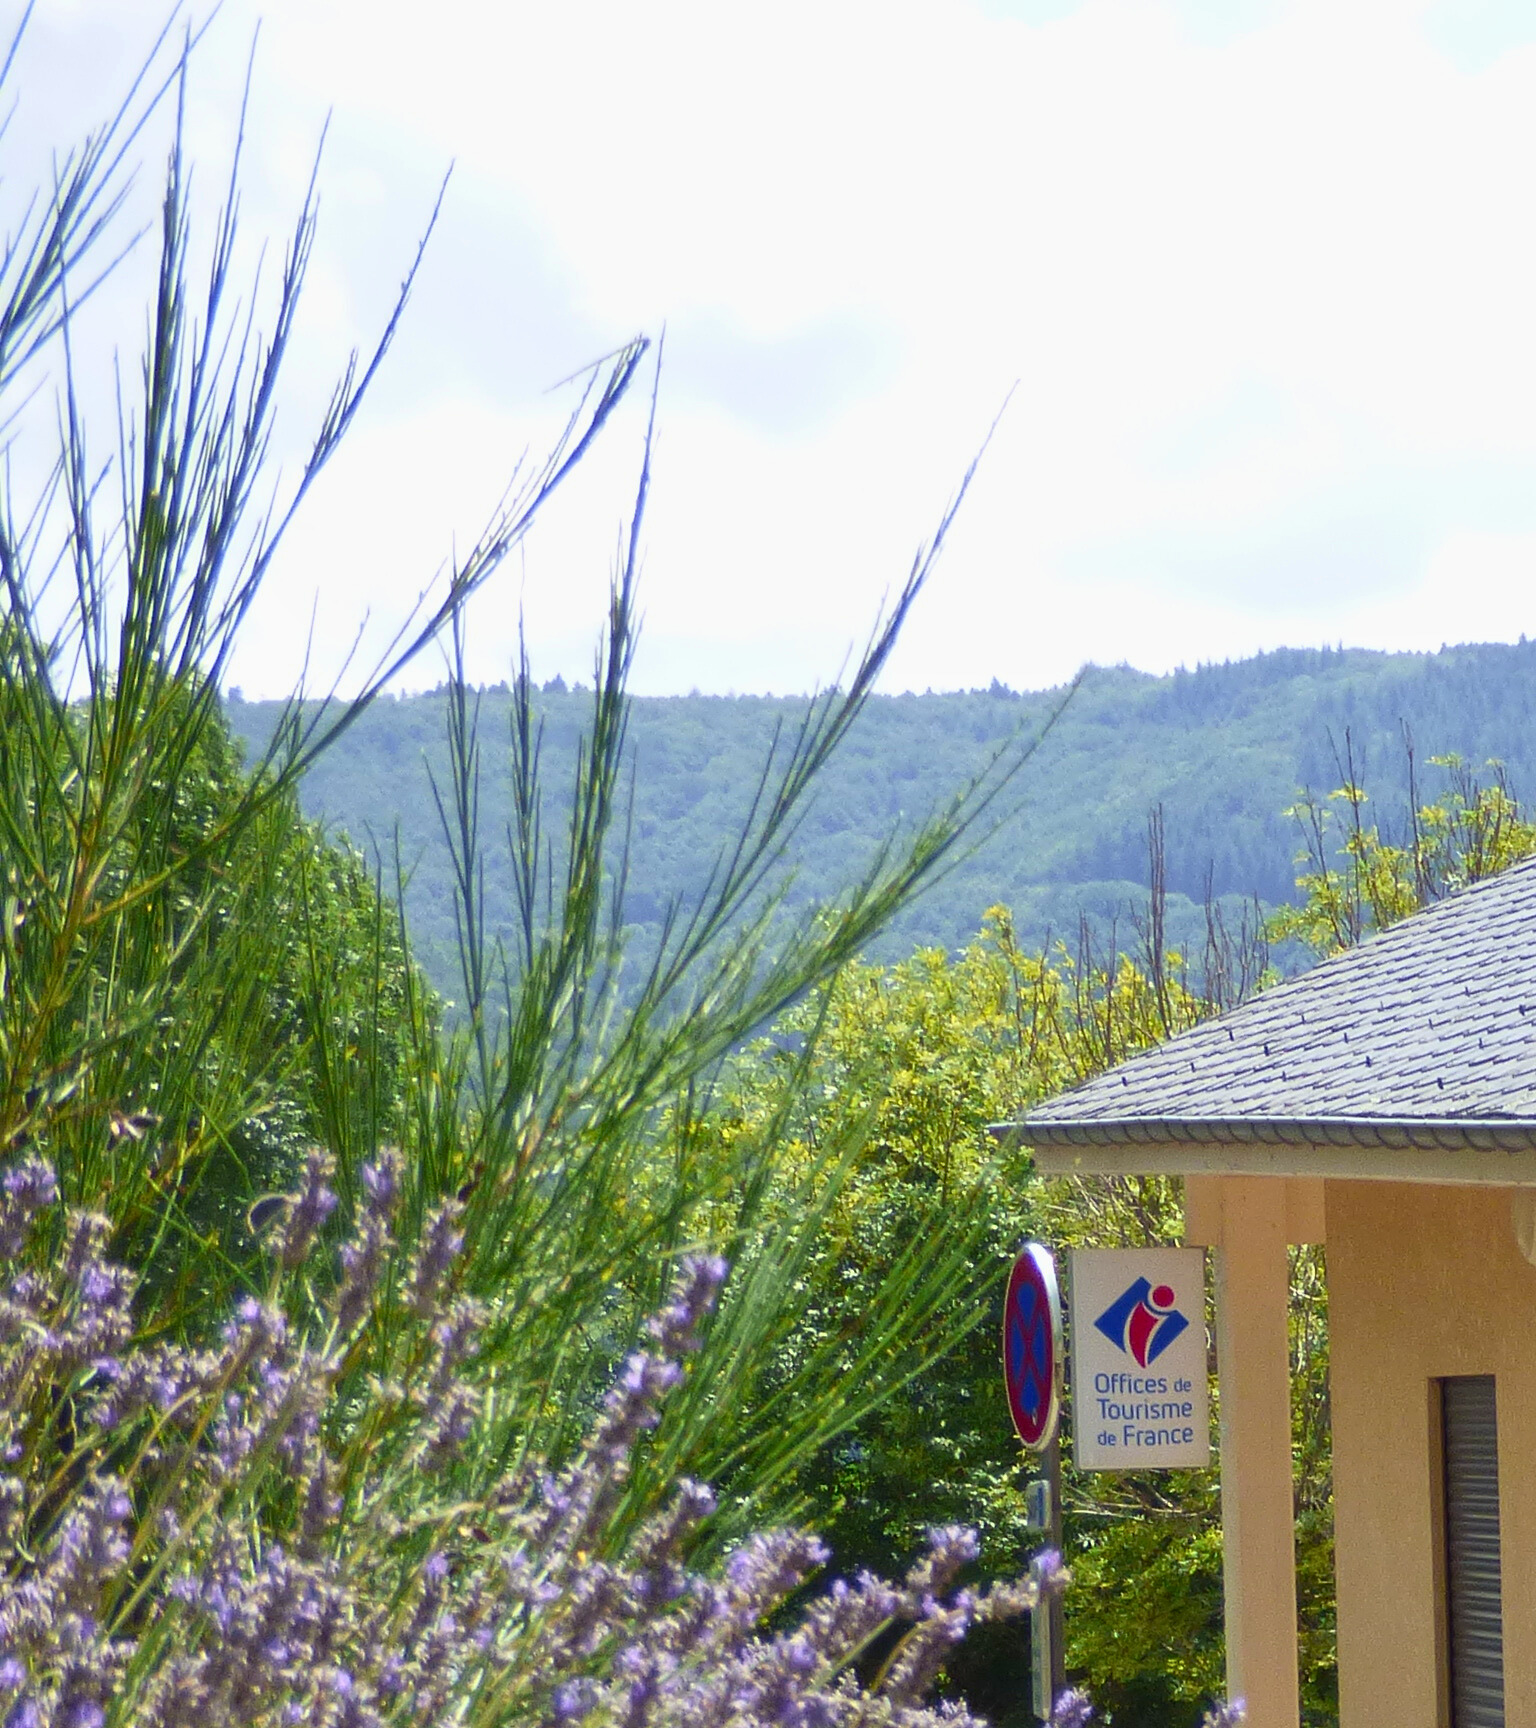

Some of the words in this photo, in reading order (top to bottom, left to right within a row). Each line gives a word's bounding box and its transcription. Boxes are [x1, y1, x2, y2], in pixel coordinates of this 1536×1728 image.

[1094, 1373, 1168, 1394] Offices
[1174, 1377, 1192, 1393] de
[1096, 1398, 1193, 1420] Tourisme
[1097, 1430, 1117, 1446] de
[1123, 1424, 1194, 1446] France
